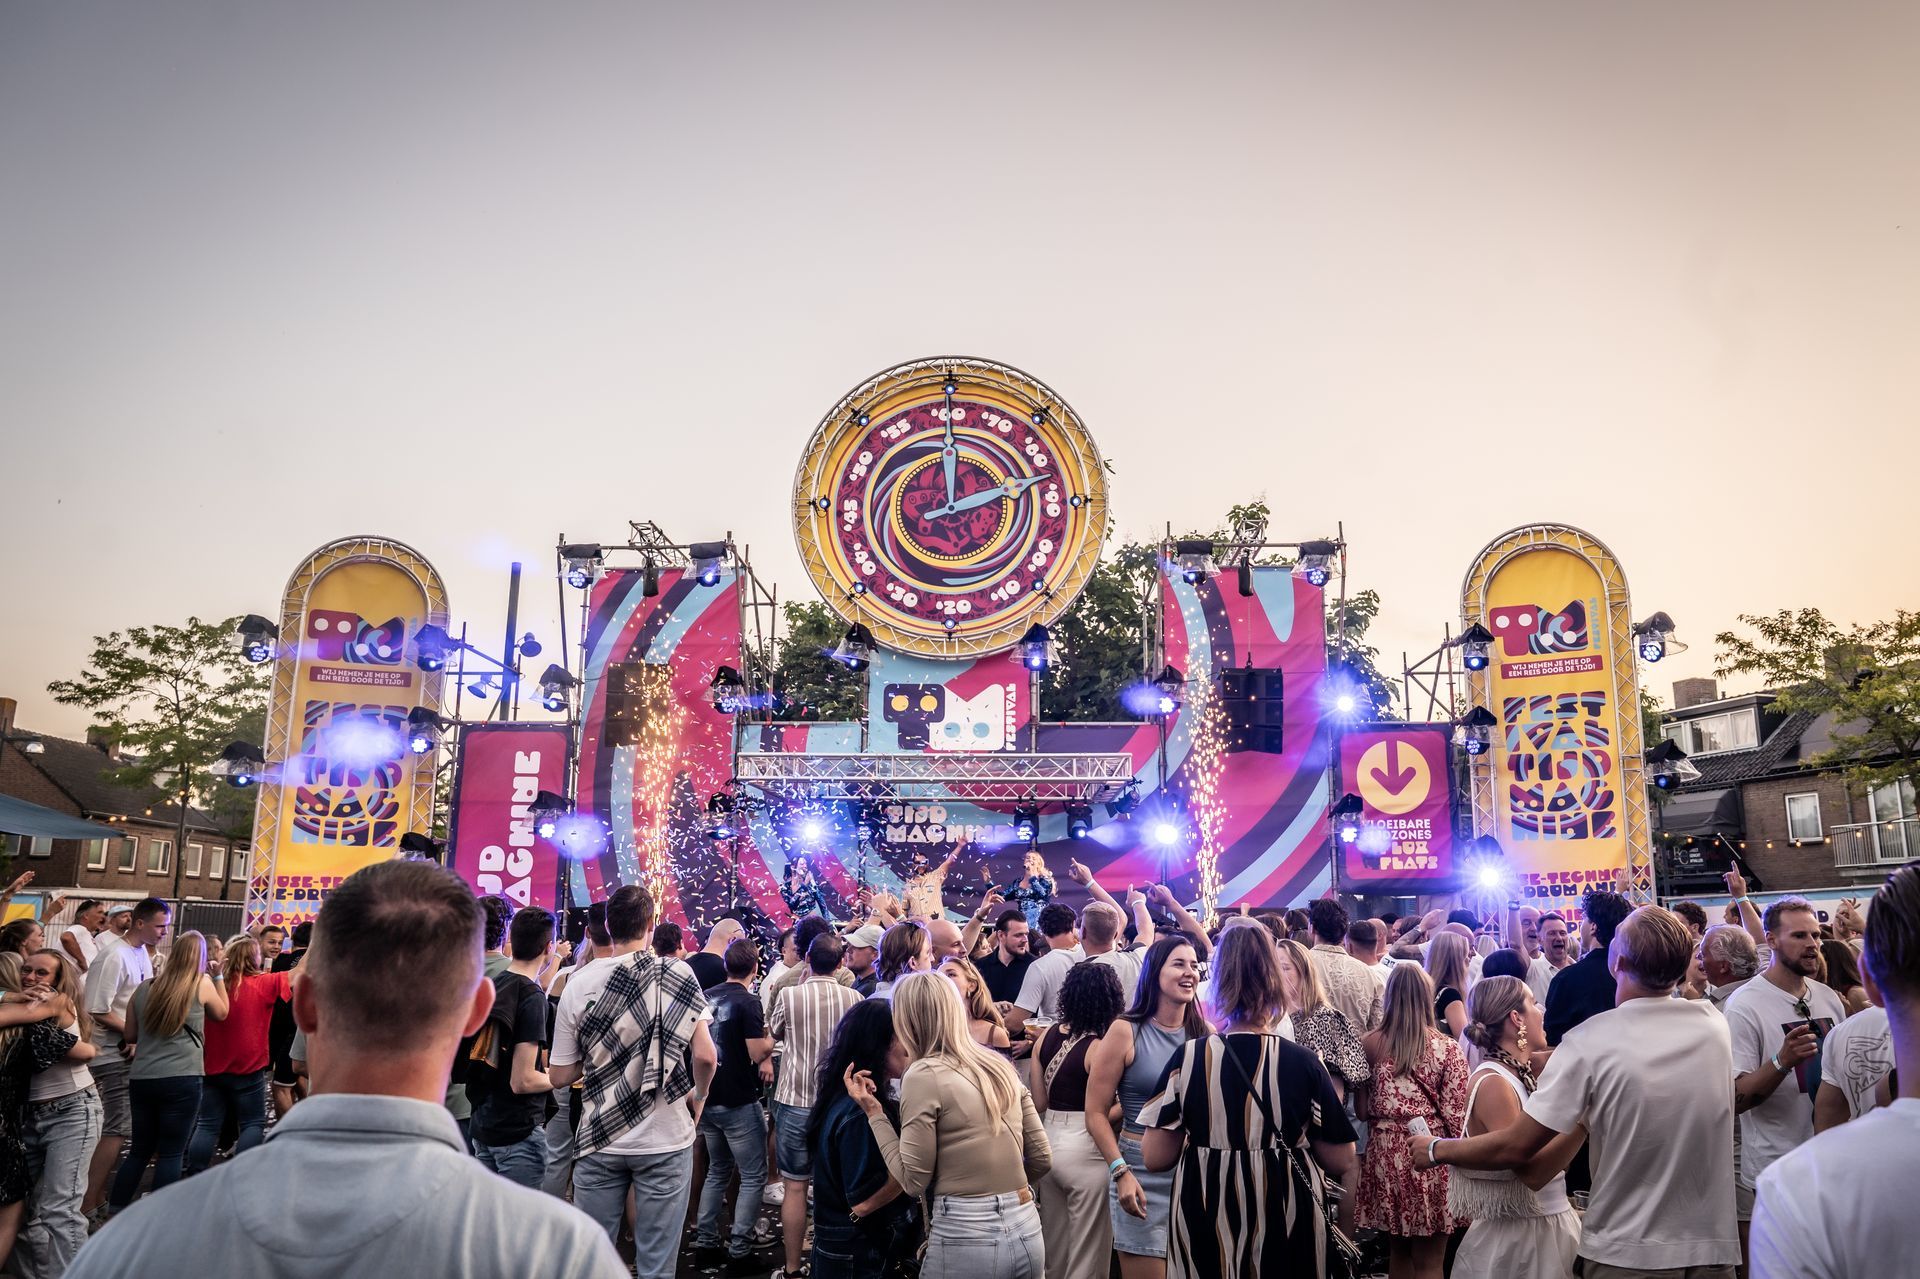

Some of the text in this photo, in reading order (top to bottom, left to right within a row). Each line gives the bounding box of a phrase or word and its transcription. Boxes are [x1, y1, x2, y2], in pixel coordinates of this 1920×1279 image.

[317, 673, 404, 686] EEN REIS DOOR DE TIJD!
[321, 668, 337, 676] WIJ
[338, 669, 363, 678] NEMEN
[364, 670, 373, 678] JE
[374, 671, 389, 679] MEE
[1511, 657, 1592, 671] WIJ NEMEN JE MEE OP
[1523, 668, 1541, 676] REIS
[1542, 666, 1564, 674] DOOR
[1565, 664, 1575, 672] DE
[1575, 663, 1596, 671] TIJD!
[1005, 683, 1017, 751] FESTIVAL
[1503, 691, 1606, 723] FEST
[1505, 719, 1610, 752] IVAL
[1507, 749, 1611, 782] TIJD
[294, 785, 399, 820] MAC
[1509, 779, 1614, 813] MAC
[504, 750, 541, 912] ACHINE
[1380, 856, 1438, 871] FLATS
